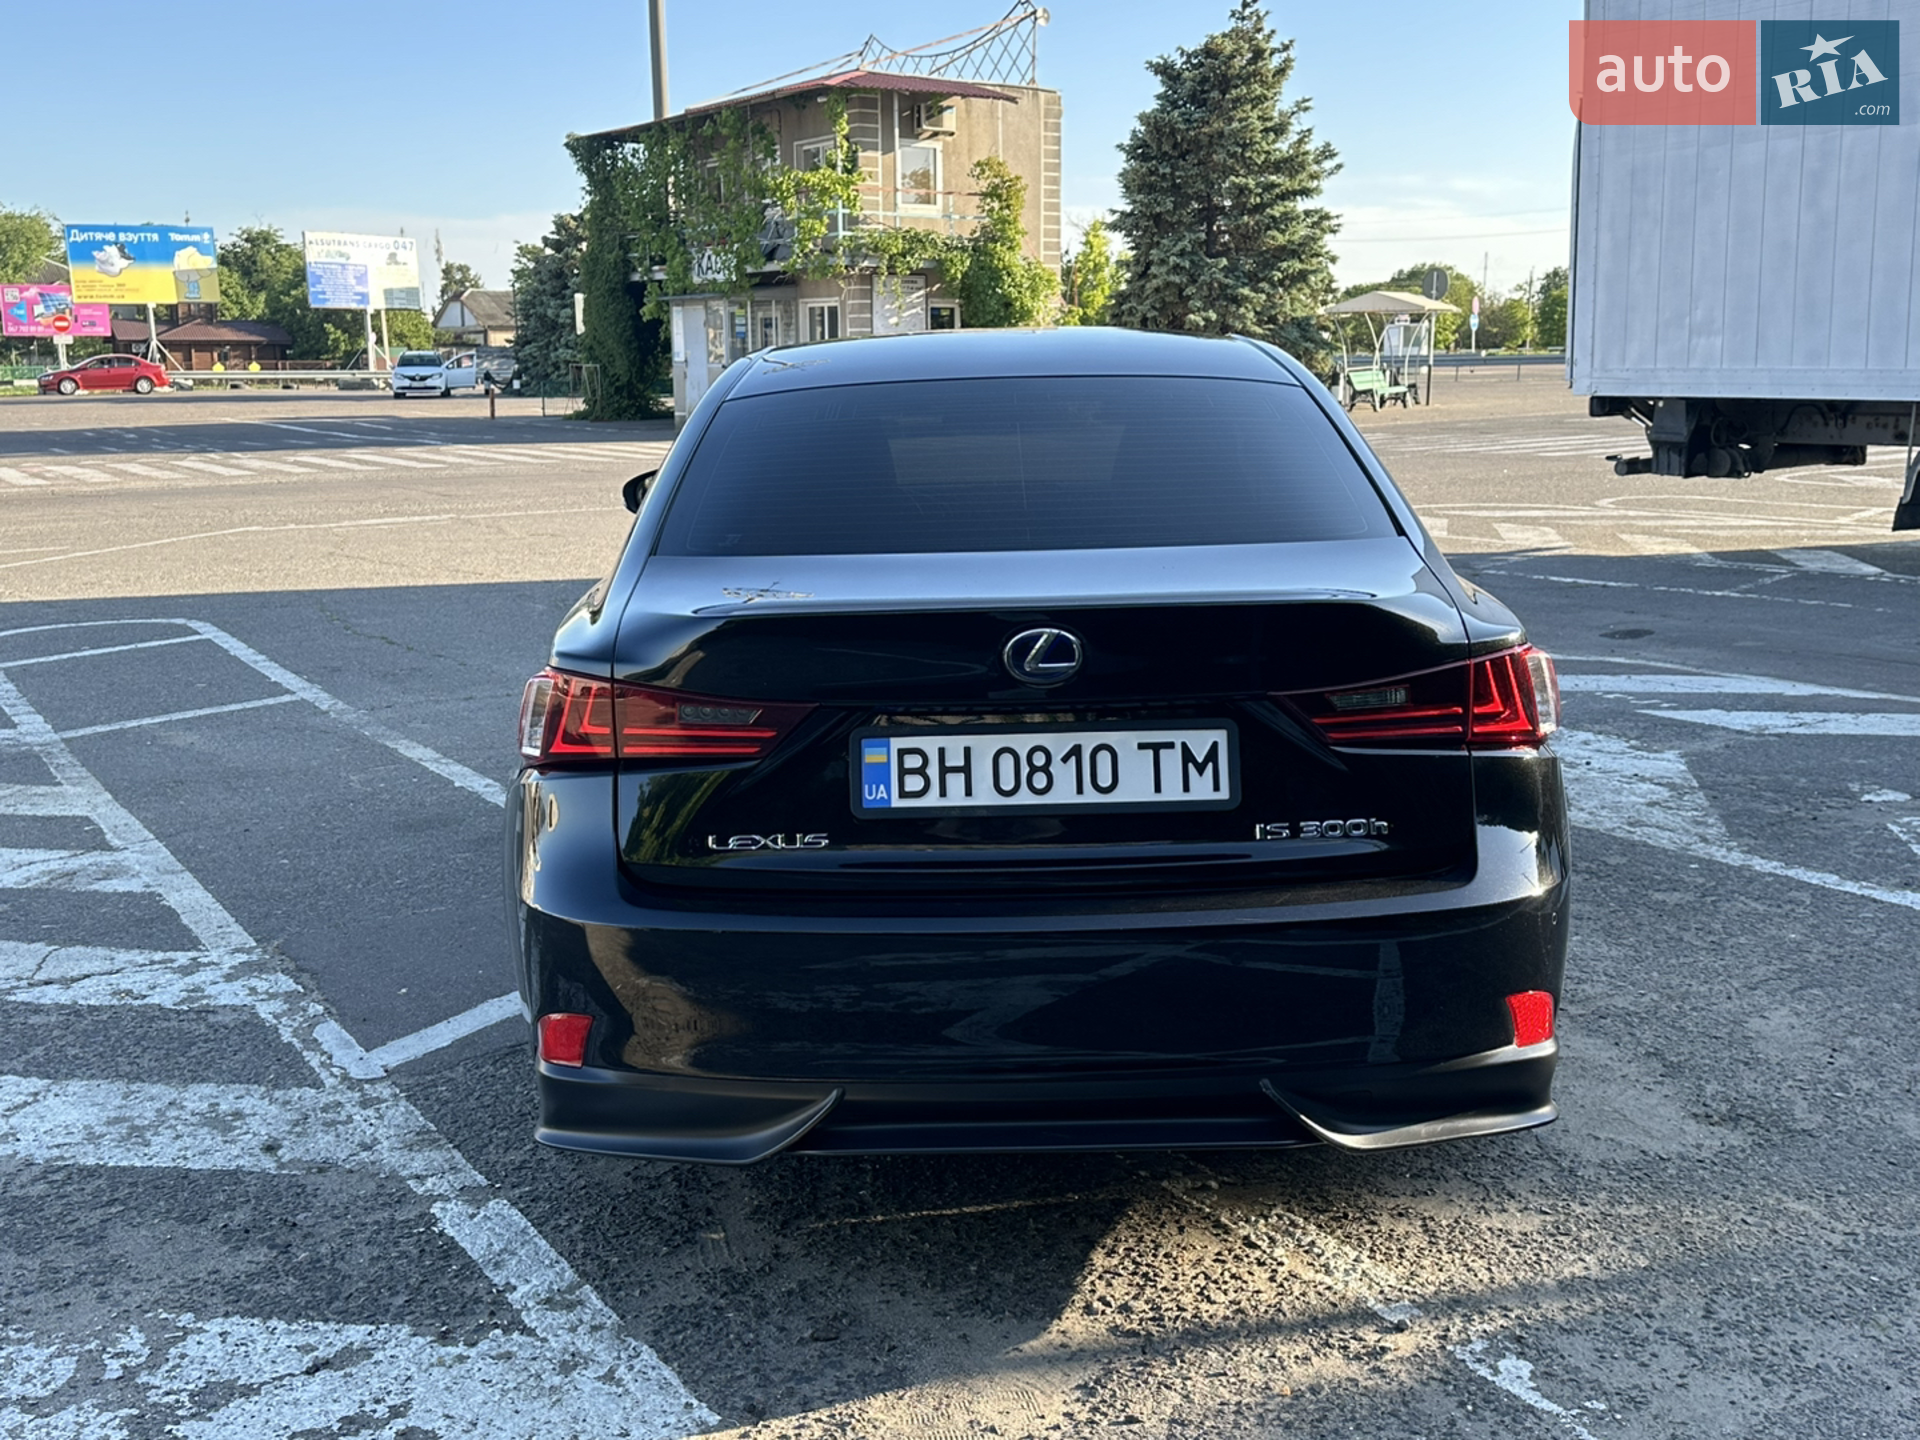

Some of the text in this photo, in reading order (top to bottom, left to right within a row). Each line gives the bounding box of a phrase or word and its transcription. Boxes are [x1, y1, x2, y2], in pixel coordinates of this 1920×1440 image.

[69, 229, 160, 244] Дитяче взуття
[393, 240, 414, 251] 047
[865, 740, 1221, 800] UA BH 0810 TM
[1255, 817, 1389, 841] IS 300h
[707, 832, 830, 850] LEXUS
